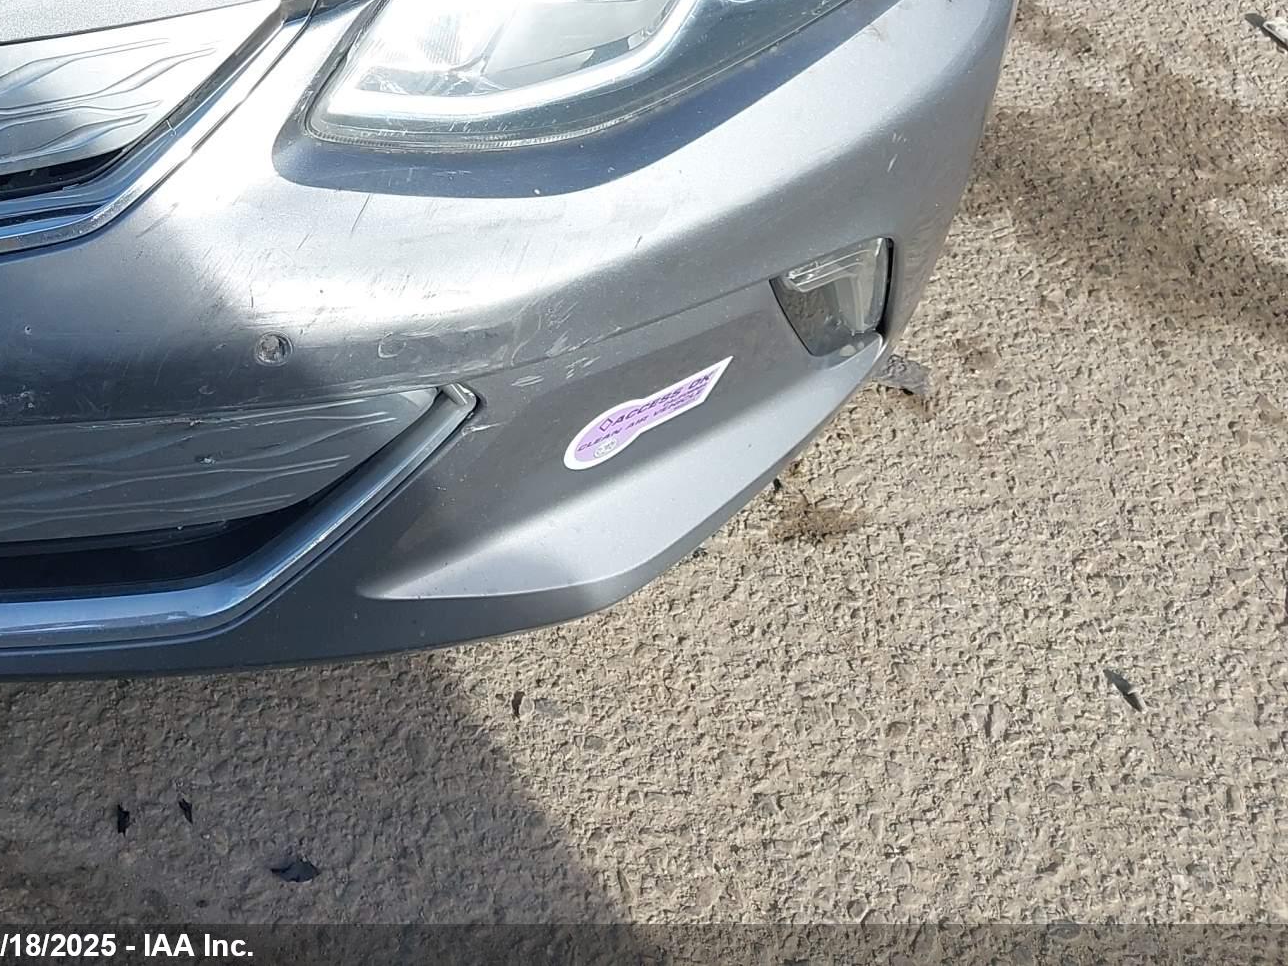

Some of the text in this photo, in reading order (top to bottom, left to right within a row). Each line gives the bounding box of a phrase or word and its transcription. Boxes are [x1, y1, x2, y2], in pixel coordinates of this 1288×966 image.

[612, 387, 682, 426] ACCESS
[688, 375, 710, 390] OK
[577, 427, 624, 452] CLEAN
[626, 416, 650, 430] AIR
